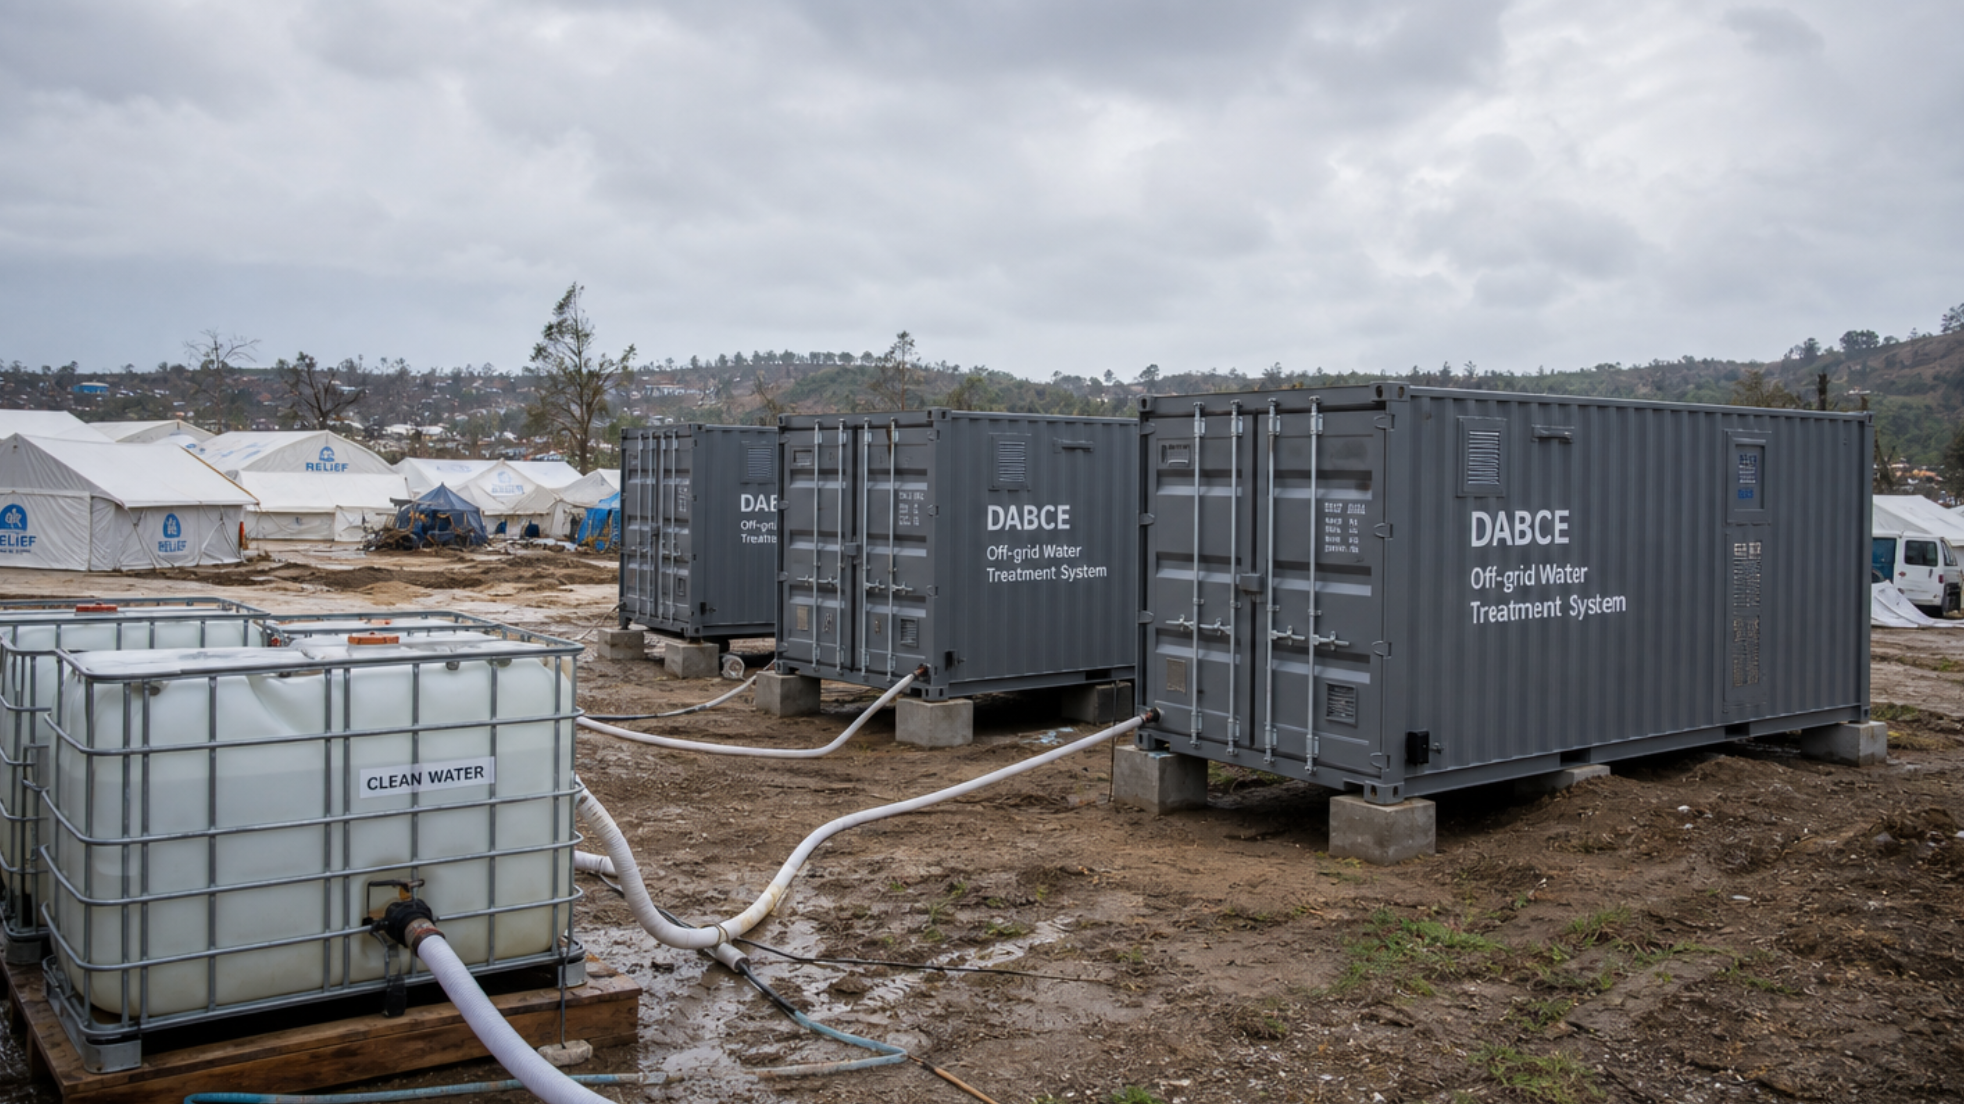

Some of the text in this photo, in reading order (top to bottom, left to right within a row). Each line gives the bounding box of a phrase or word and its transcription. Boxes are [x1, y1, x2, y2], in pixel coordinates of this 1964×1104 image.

[305, 462, 349, 472] RELIEF
[987, 504, 1071, 531] DABCE
[1471, 509, 1570, 547] DABCE
[986, 544, 1082, 564] Off-grid Water
[986, 563, 1108, 583] Treatment System
[1470, 562, 1589, 593] Off-grid Water
[1470, 593, 1627, 625] Treatment System
[366, 765, 484, 791] CLEAN WATER
